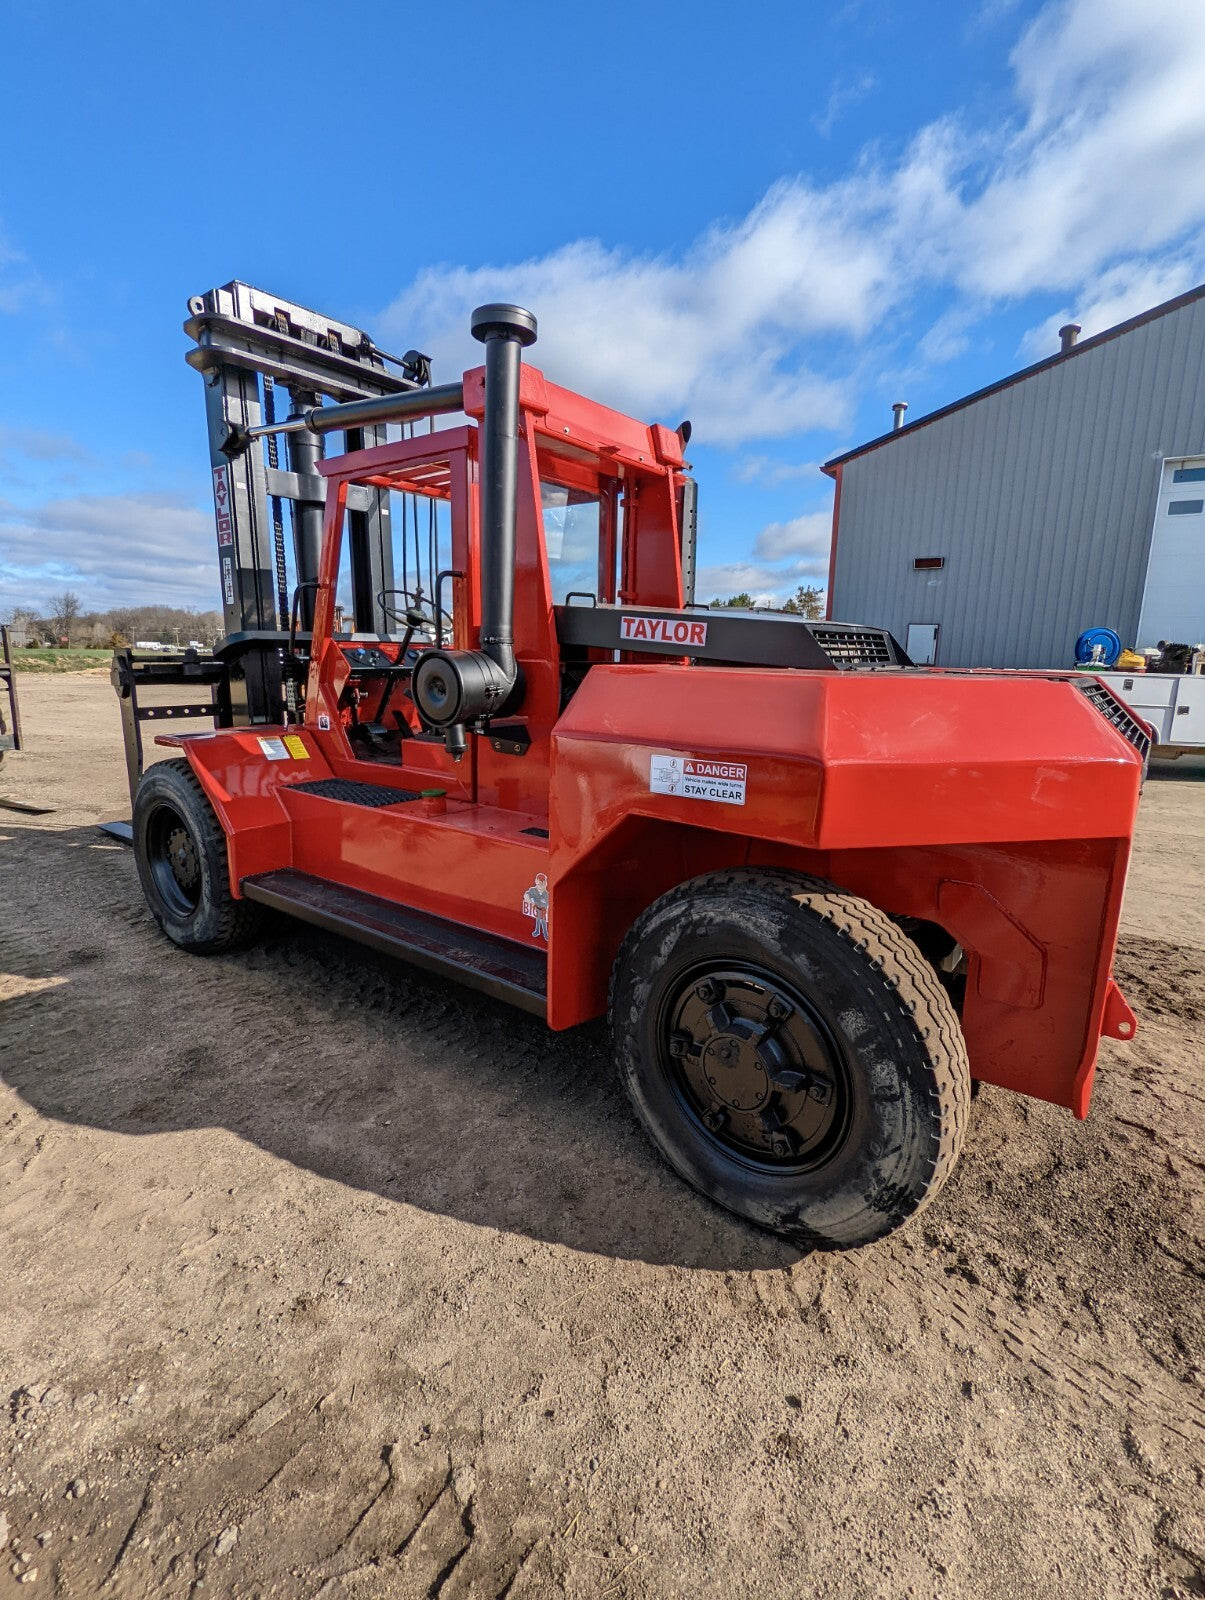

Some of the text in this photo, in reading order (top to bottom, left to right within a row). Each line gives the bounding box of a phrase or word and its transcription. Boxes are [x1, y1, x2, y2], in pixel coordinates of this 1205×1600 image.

[214, 467, 232, 544] TAYLOR
[623, 618, 704, 644] TAYLOR
[697, 764, 744, 778] DANGER
[685, 785, 742, 800] STAY CLEAR
